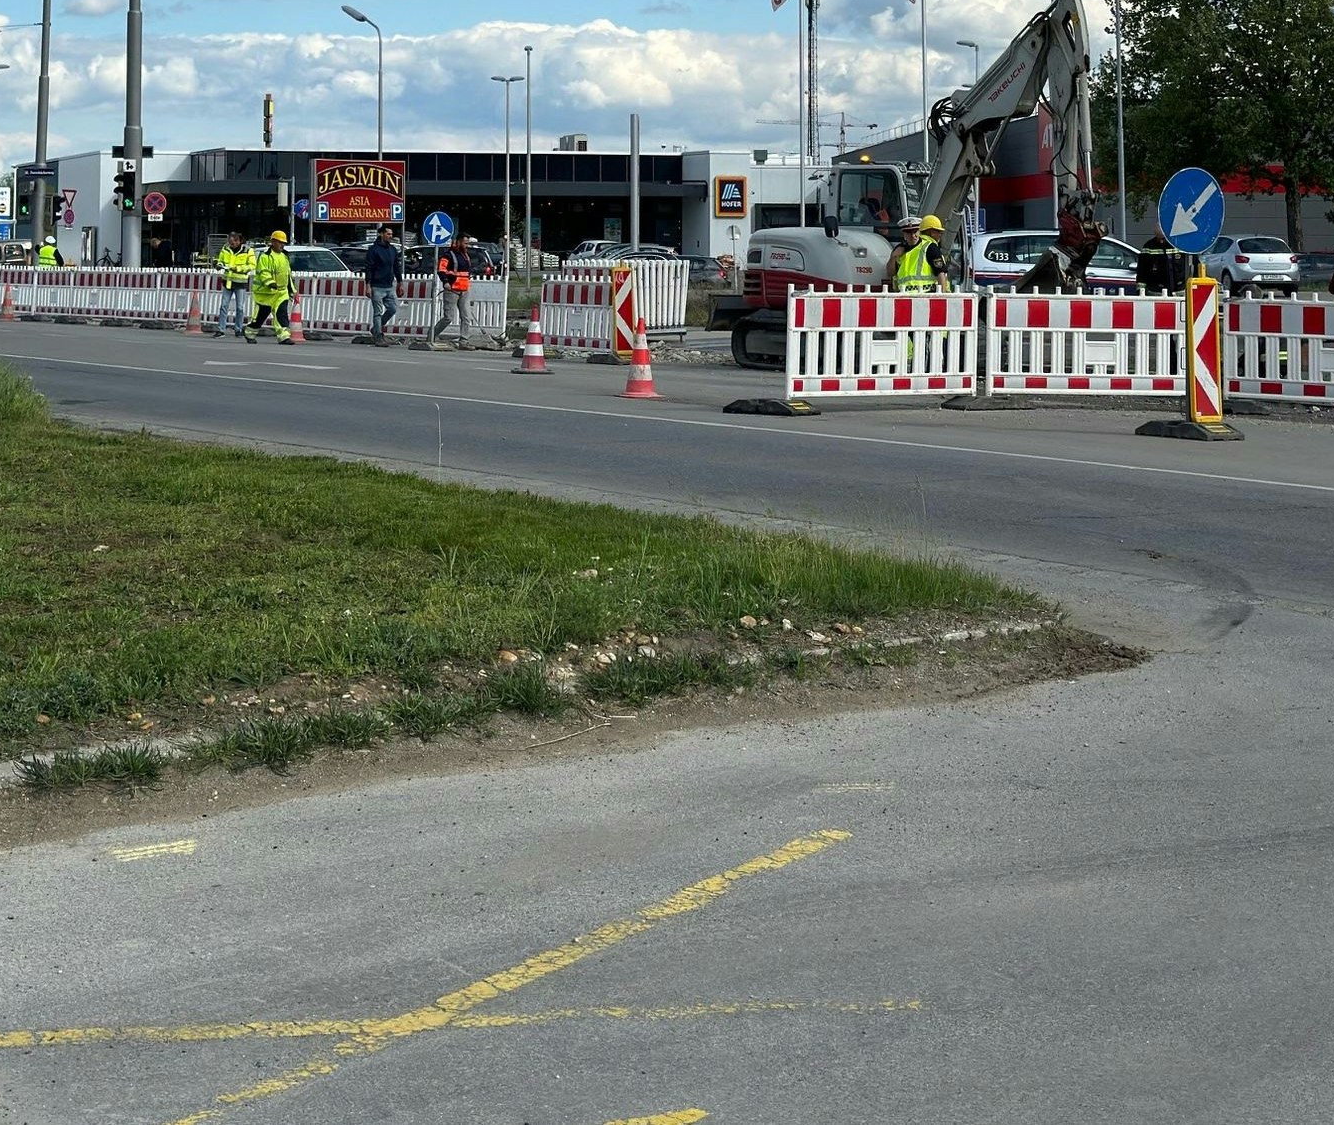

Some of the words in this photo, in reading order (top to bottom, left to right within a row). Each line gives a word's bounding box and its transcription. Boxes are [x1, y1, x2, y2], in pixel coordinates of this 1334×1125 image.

[987, 61, 1026, 103] TAKEUCHI
[318, 166, 401, 194] JASMIN
[349, 195, 371, 206] ASIA
[318, 203, 327, 218] P
[330, 207, 390, 218] RESTAURANT
[392, 204, 402, 219] P
[994, 252, 1010, 261] 133
